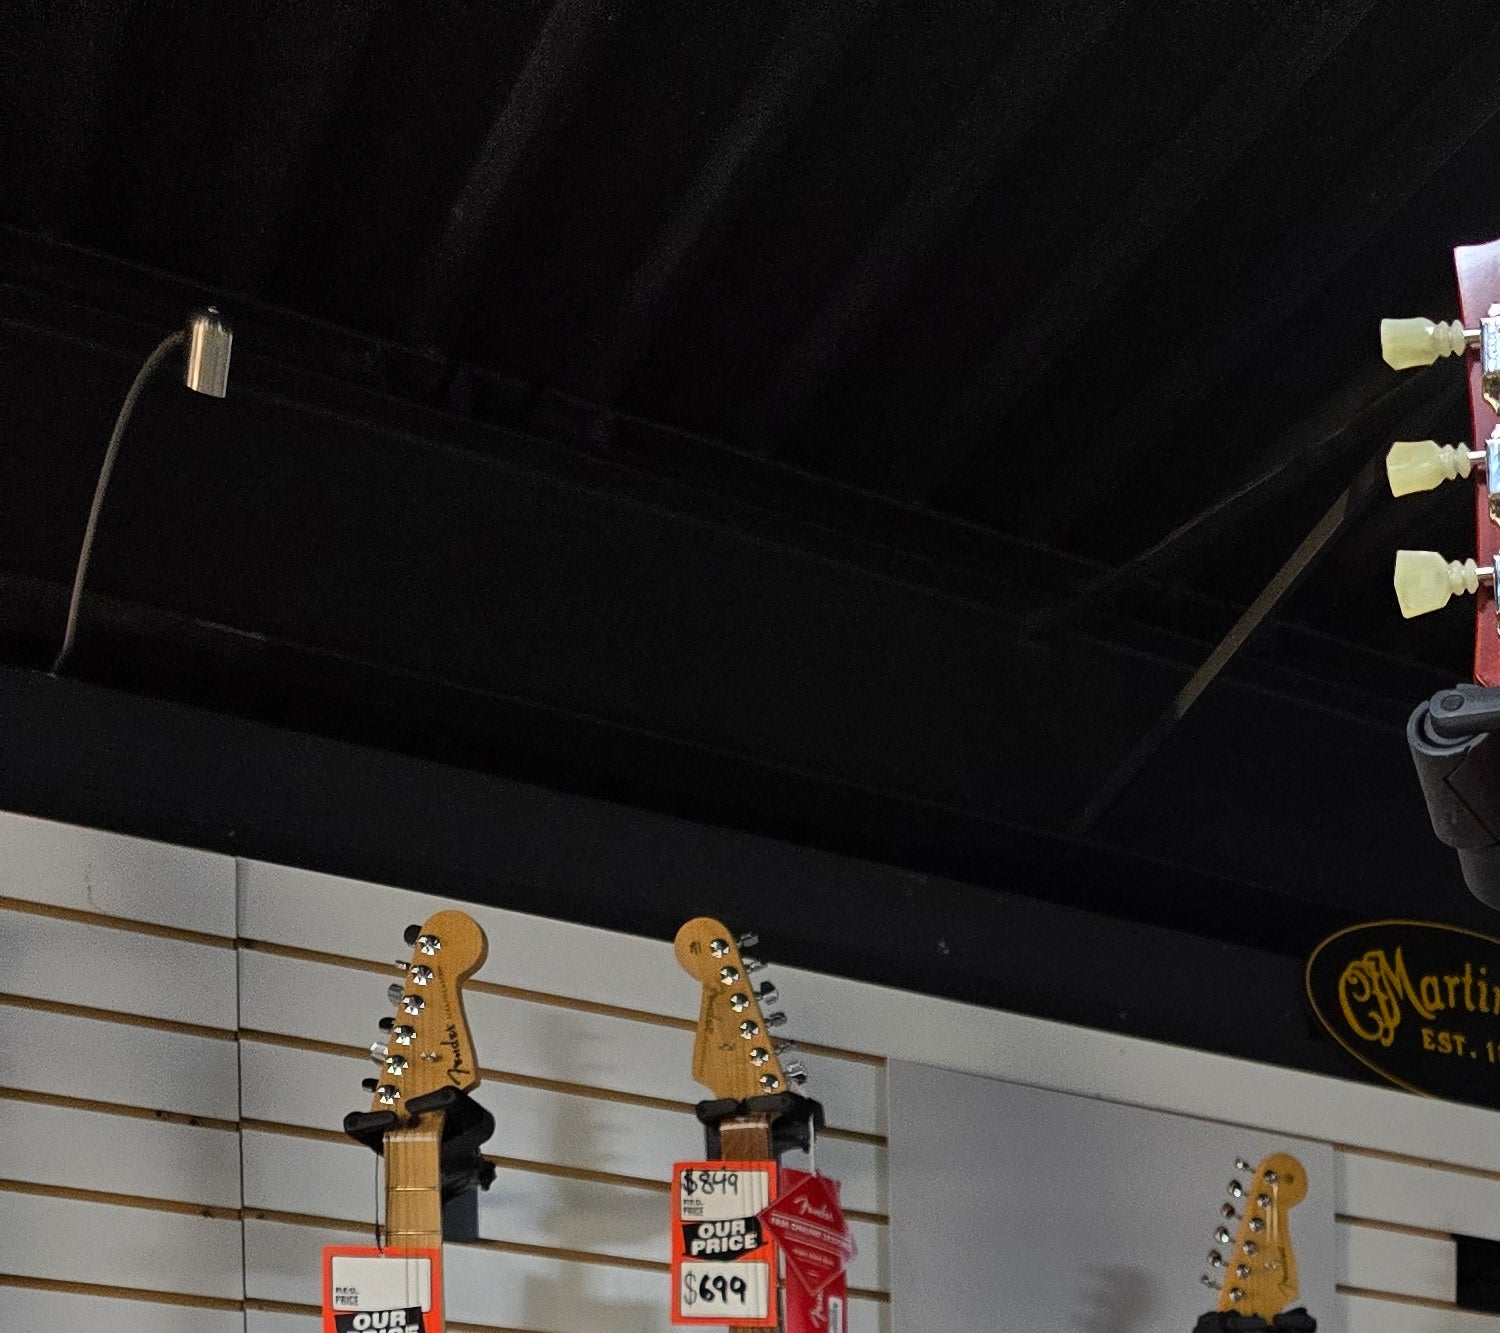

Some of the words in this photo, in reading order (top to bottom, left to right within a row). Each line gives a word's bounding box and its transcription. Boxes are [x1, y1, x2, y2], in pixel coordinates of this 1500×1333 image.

[440, 1024, 470, 1086] Fender
[1421, 1027, 1477, 1060] EST.
[683, 1169, 739, 1196] $849
[697, 1220, 746, 1238] OUR
[691, 1235, 758, 1256] PRICE
[683, 1270, 747, 1307] $699
[352, 1310, 406, 1331] OUR
